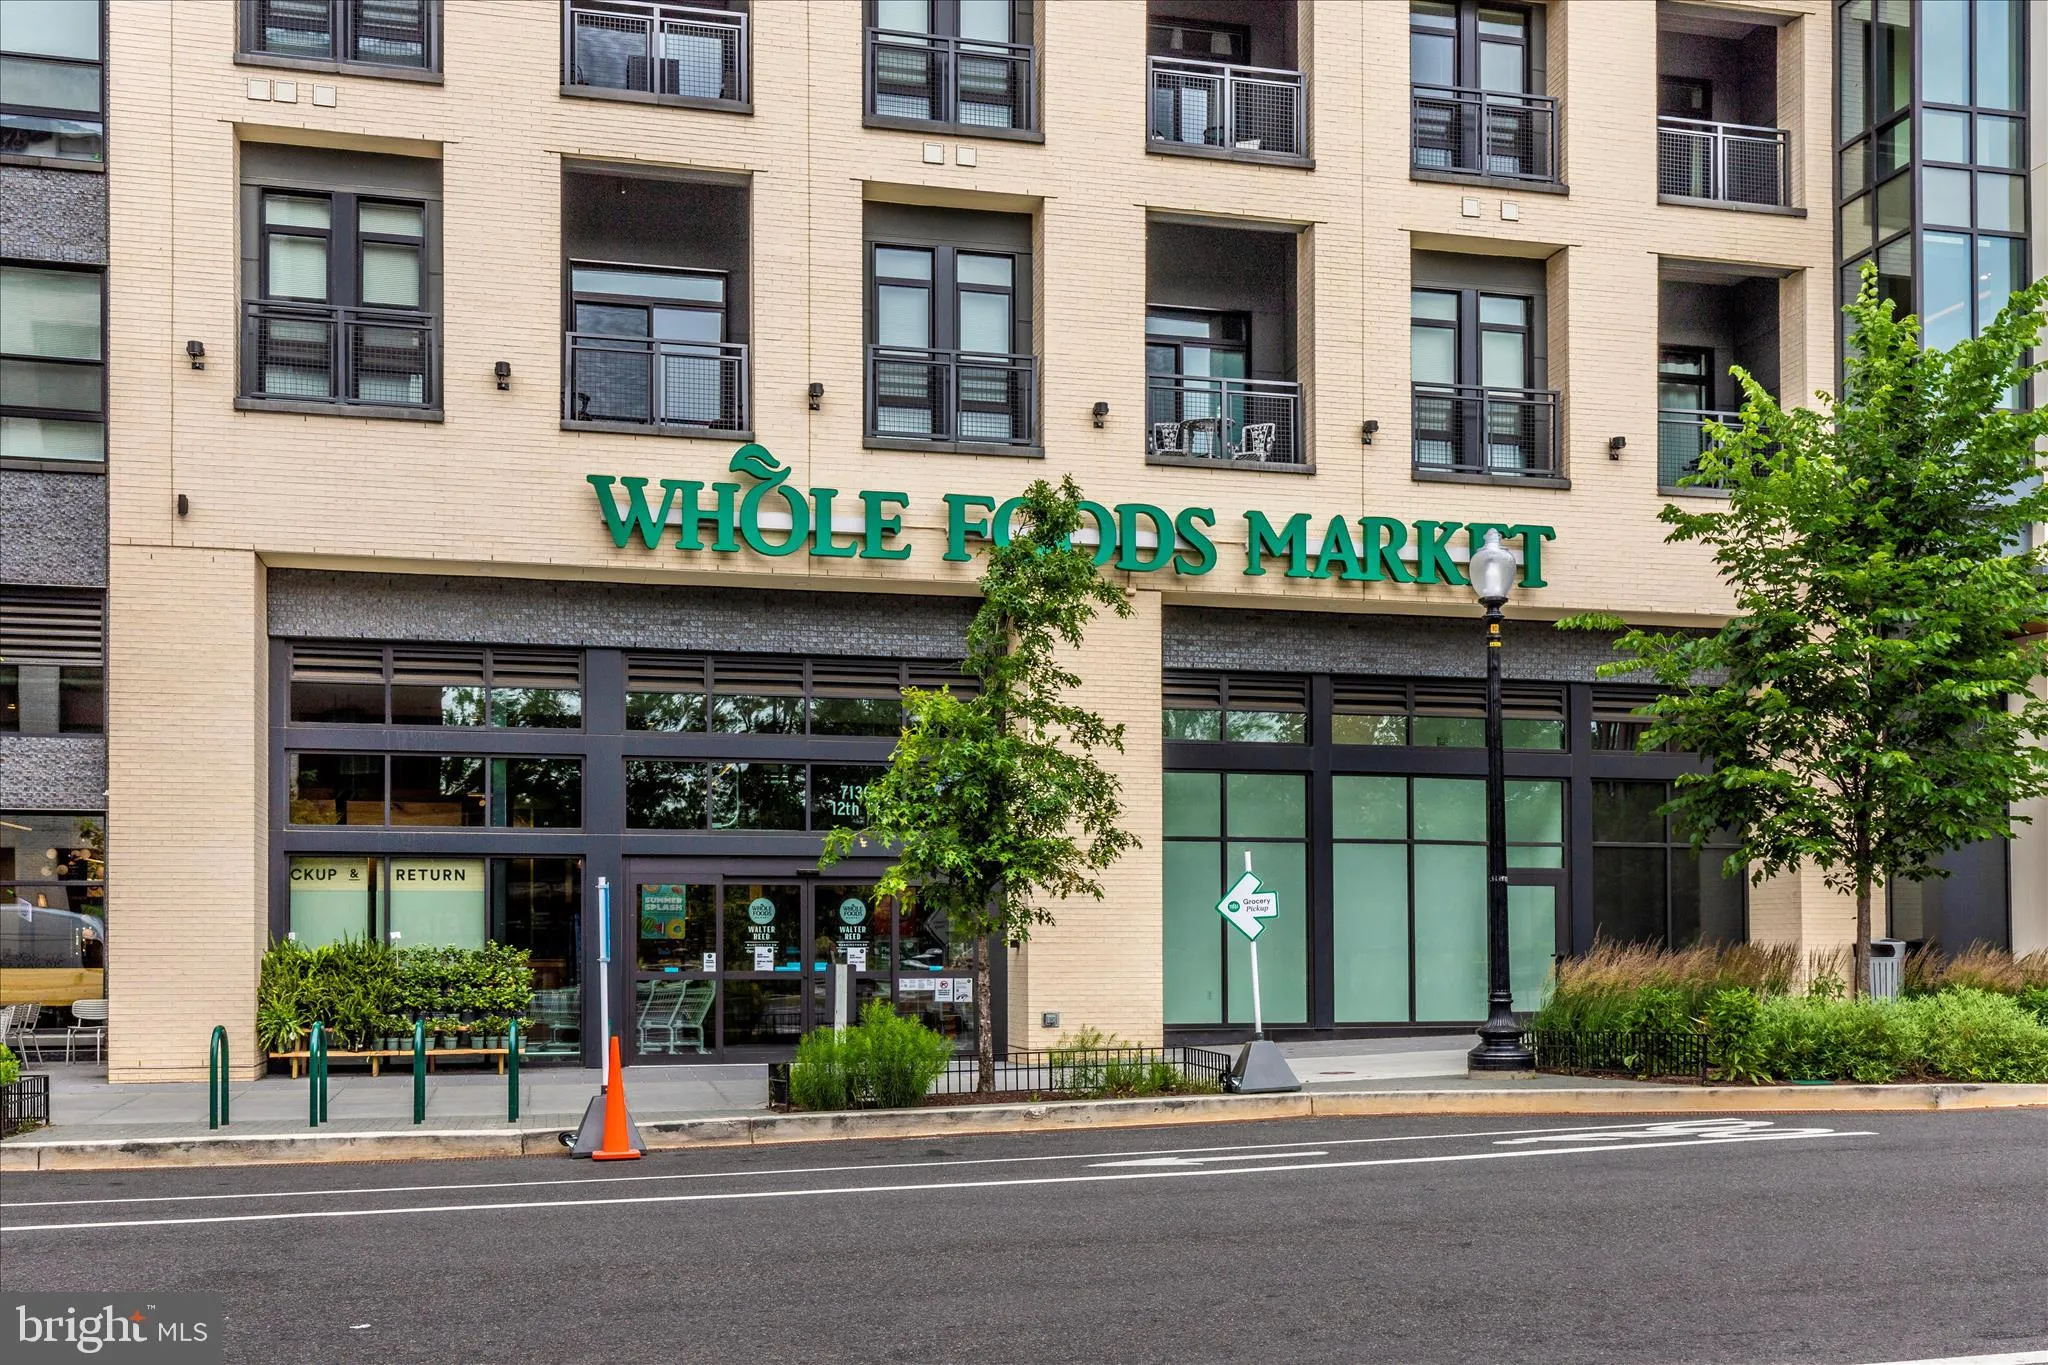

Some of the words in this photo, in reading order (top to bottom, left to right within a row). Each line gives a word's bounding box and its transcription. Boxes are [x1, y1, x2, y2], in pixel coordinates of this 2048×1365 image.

[587, 462, 911, 557] WHOLE
[832, 801, 860, 816] 12th
[290, 868, 337, 881] CKUP
[349, 868, 360, 881] &
[396, 869, 466, 881] RETURN
